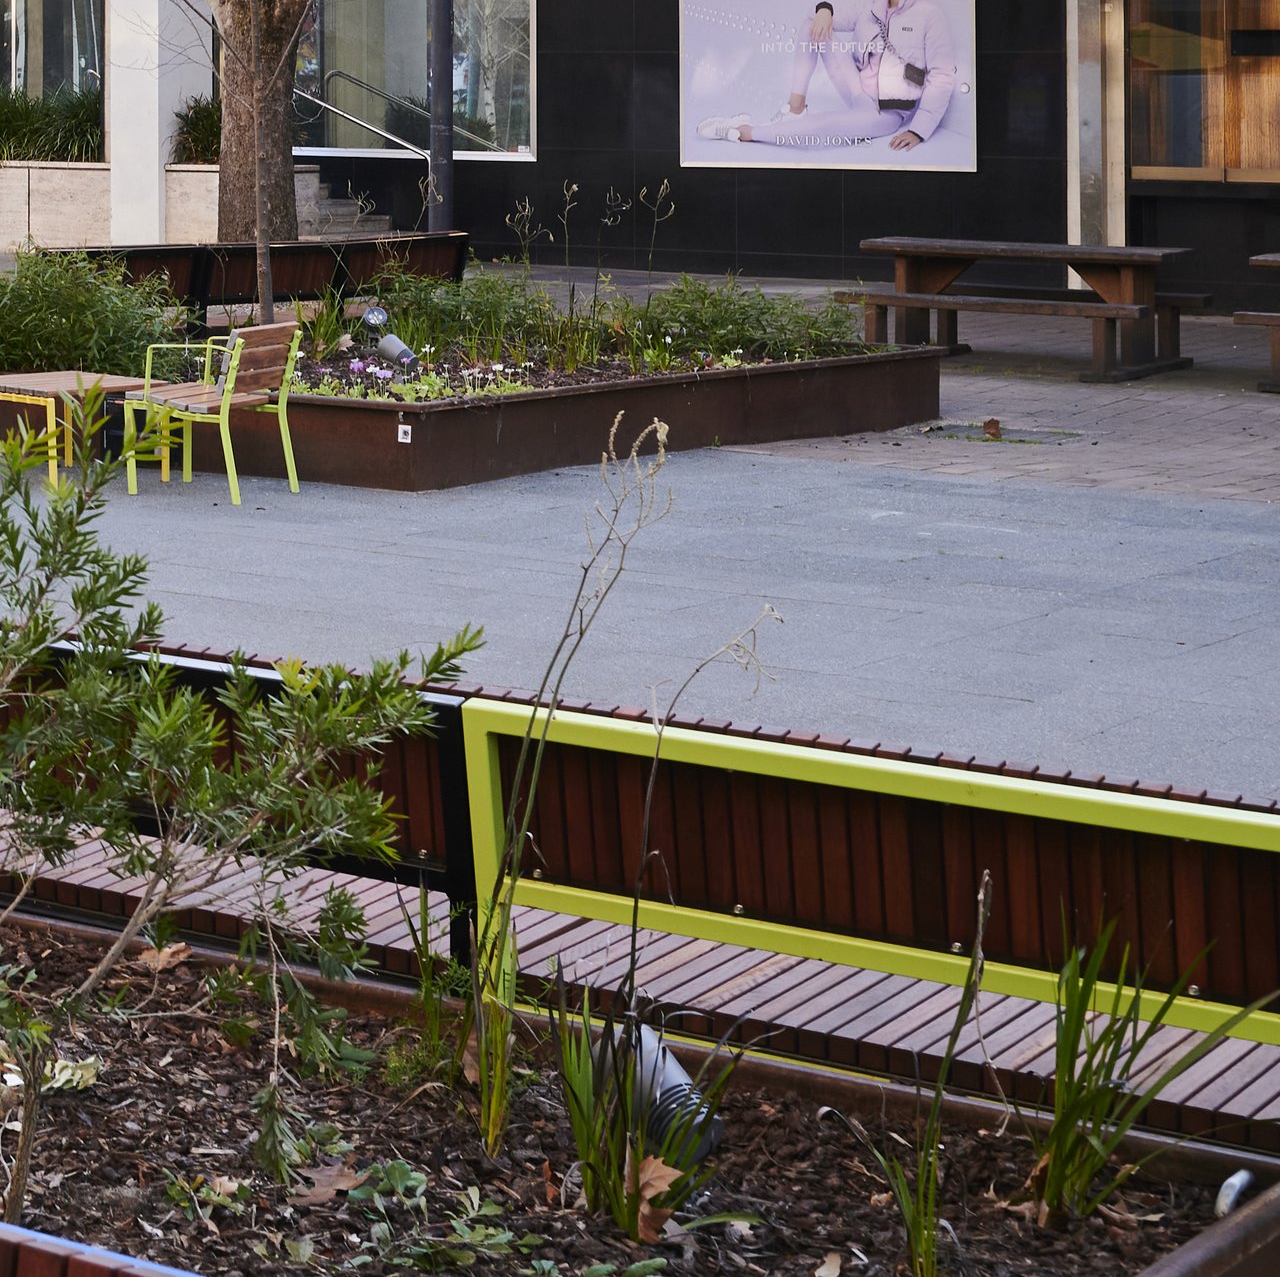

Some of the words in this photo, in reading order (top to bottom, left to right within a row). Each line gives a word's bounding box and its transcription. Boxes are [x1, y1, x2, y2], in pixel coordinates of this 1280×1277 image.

[761, 42, 795, 53] INTO
[800, 42, 827, 53] THE
[831, 42, 884, 53] FUTURE
[776, 135, 820, 146] DAVID
[824, 135, 872, 146] JONES
